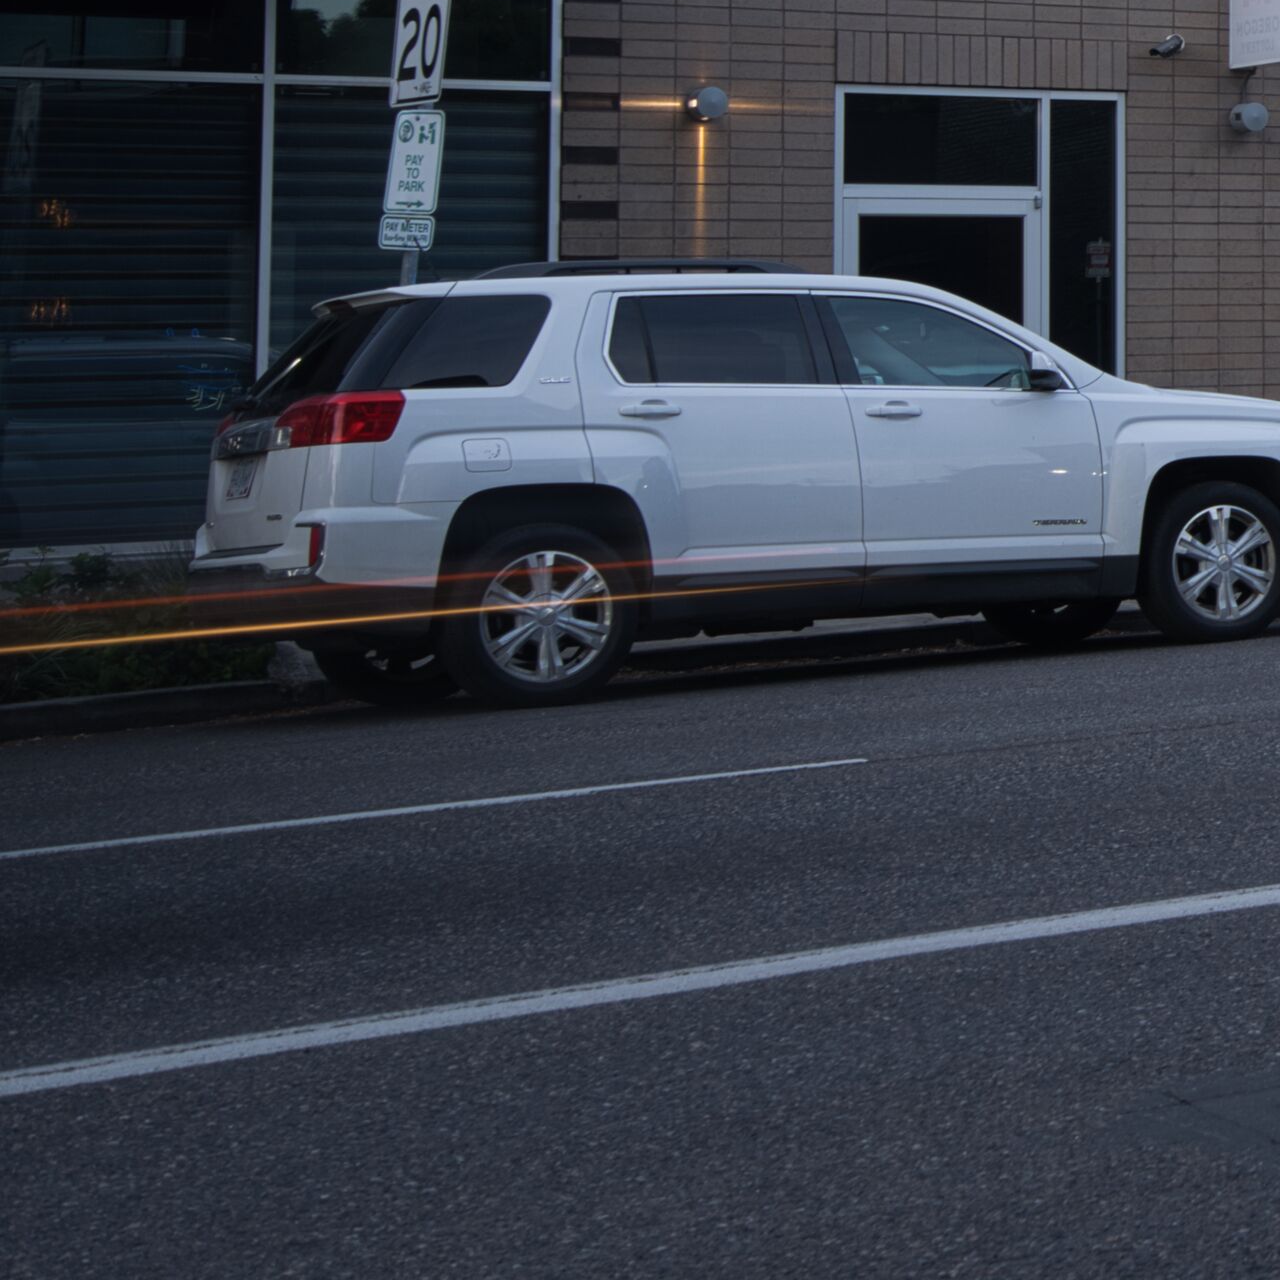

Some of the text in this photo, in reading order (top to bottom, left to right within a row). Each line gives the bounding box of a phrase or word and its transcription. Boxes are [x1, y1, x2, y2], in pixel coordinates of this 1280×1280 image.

[397, 4, 442, 79] 20
[405, 154, 425, 166] PAY
[406, 167, 420, 179] TO
[398, 180, 426, 193] PARK
[385, 222, 429, 233] PAY METER
